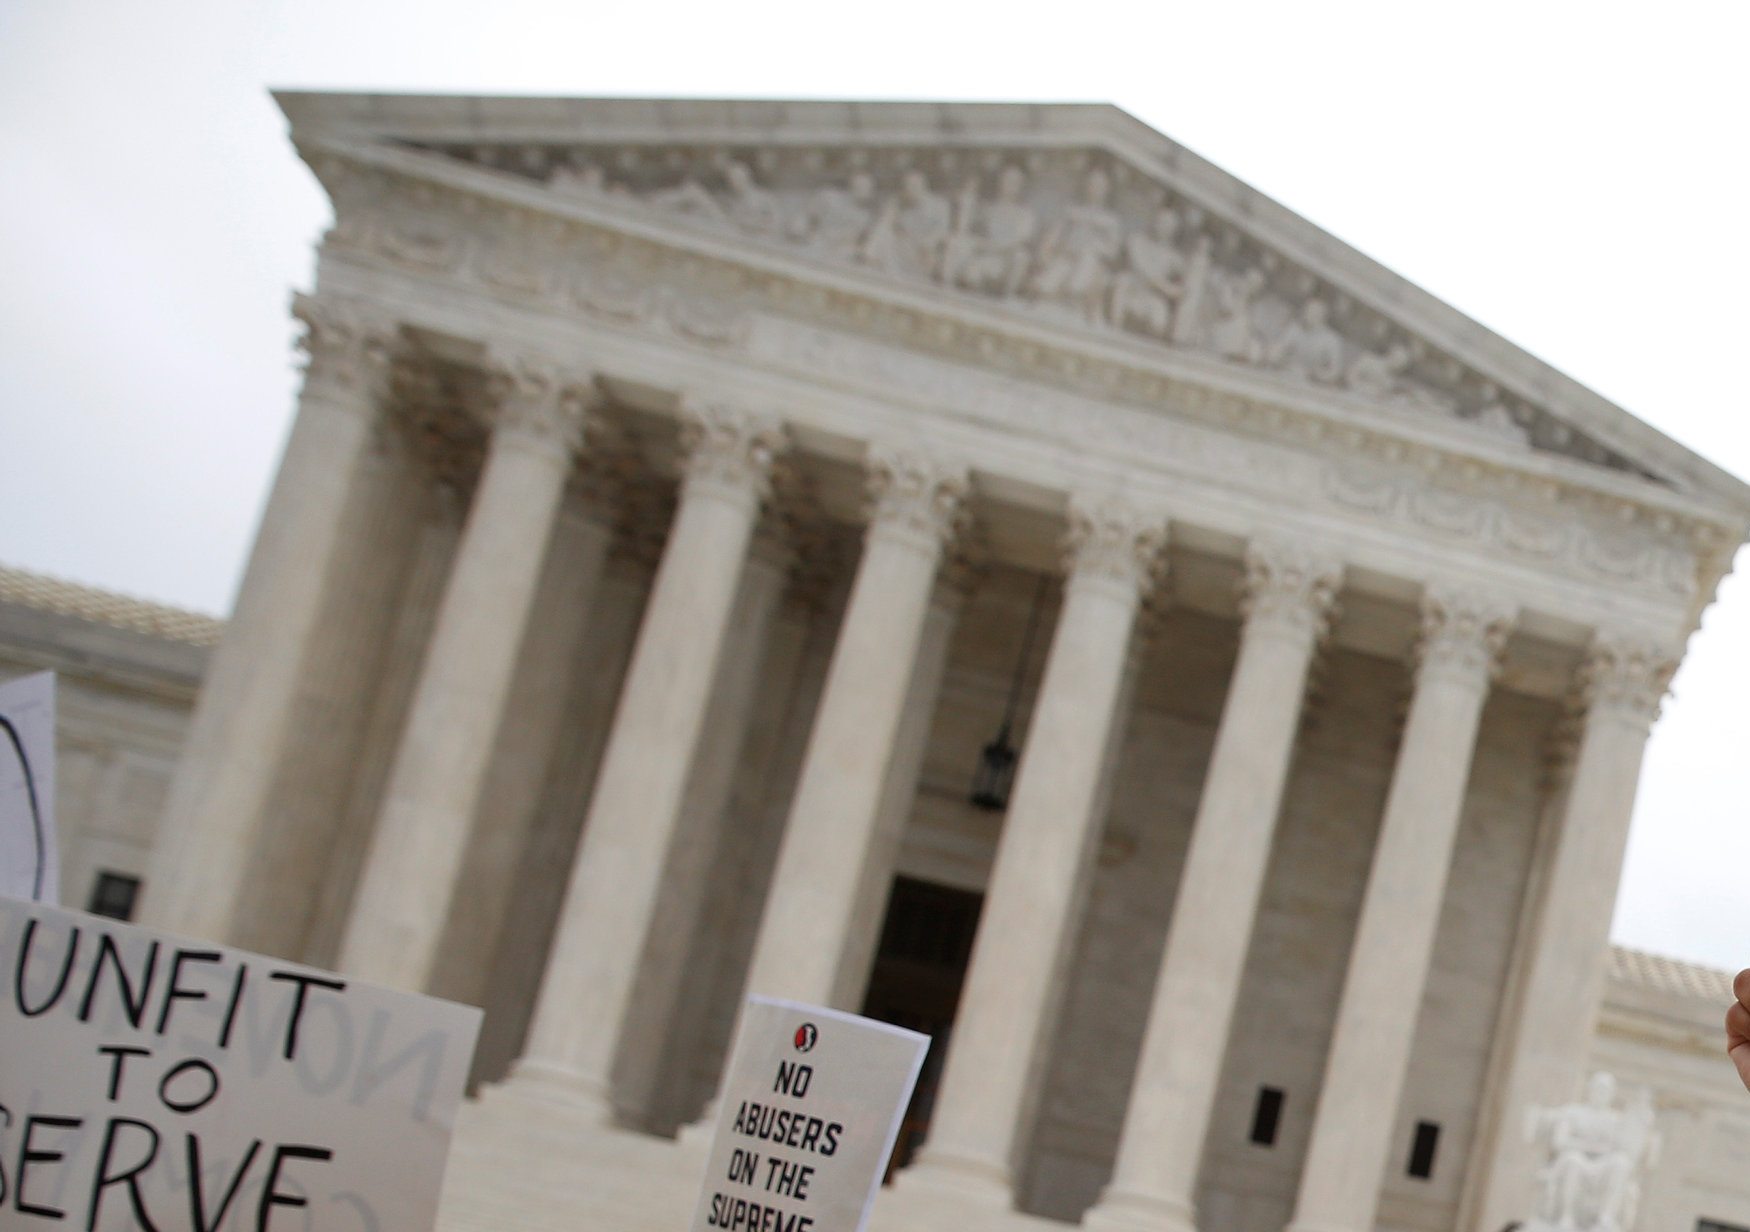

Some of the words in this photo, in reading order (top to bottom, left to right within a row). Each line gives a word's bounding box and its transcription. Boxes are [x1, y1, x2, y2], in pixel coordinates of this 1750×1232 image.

[16, 919, 346, 1060] UNFIT
[98, 1045, 220, 1114] TO
[773, 1060, 814, 1099] NO
[732, 1101, 844, 1157] ABUSERS
[727, 1148, 760, 1186] ON
[764, 1157, 815, 1201] THE
